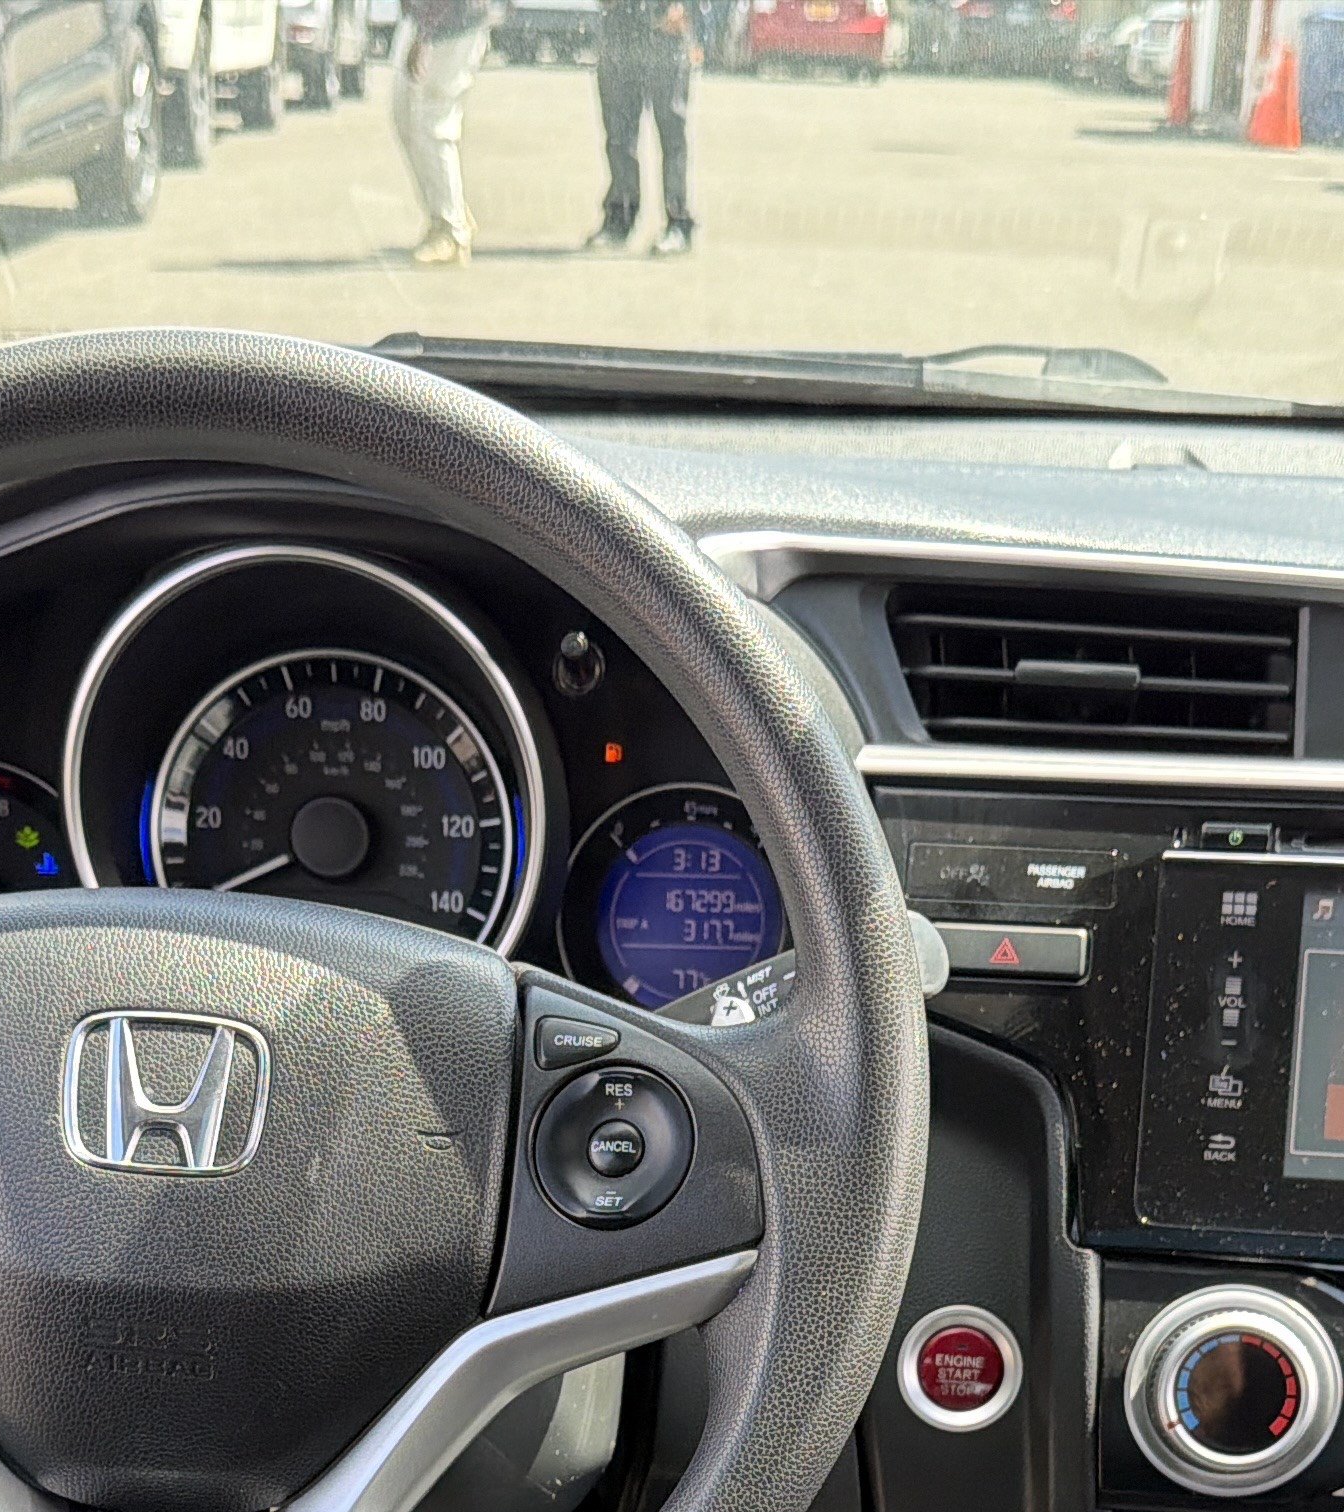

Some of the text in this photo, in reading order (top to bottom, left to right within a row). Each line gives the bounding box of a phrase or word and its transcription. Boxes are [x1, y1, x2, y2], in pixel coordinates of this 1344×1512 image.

[285, 697, 312, 719] 60
[360, 700, 386, 722] 80
[223, 737, 249, 760] 40
[413, 746, 446, 769] 100
[195, 806, 222, 829] 20
[442, 815, 474, 839] 120
[674, 849, 721, 872] 3:13
[1027, 863, 1087, 879] PASSENGER
[1037, 877, 1075, 890] AIRBAG
[431, 890, 464, 913] 140
[1220, 914, 1257, 928] HOME
[753, 982, 778, 1005] OFF
[757, 998, 778, 1018] INT
[1218, 996, 1247, 1010] VOL
[553, 1034, 603, 1048] CRUISE
[604, 1082, 633, 1098] RES
[1207, 1096, 1243, 1110] MENU
[591, 1139, 637, 1154] CANCEL
[1203, 1149, 1236, 1162] BACK
[594, 1194, 623, 1208] SET
[934, 1353, 986, 1369] ENGINE
[937, 1367, 981, 1381] START
[940, 1382, 976, 1396] STOP
